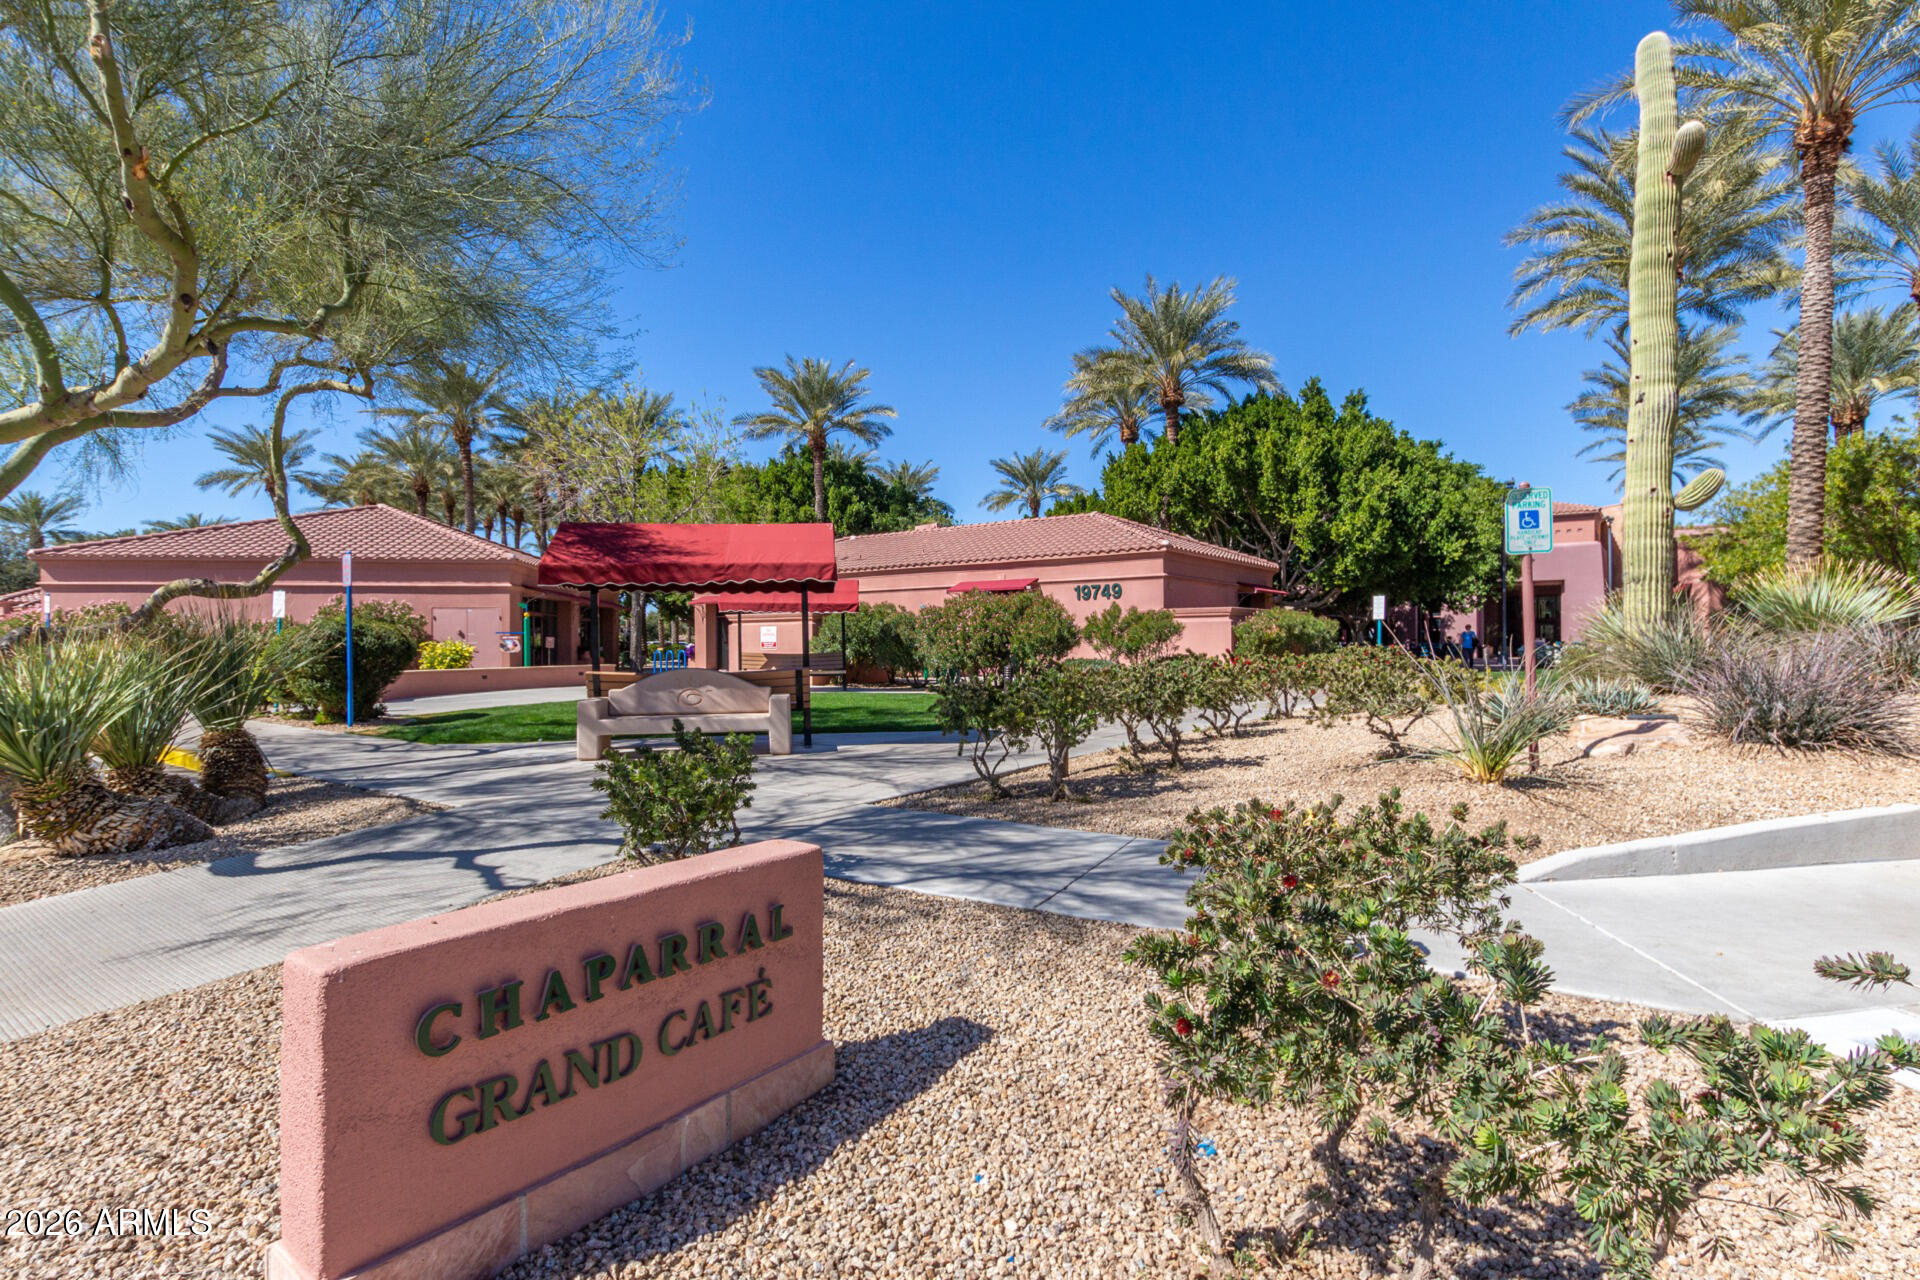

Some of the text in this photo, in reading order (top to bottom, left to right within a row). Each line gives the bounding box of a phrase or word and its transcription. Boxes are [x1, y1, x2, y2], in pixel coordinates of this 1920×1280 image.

[1073, 583, 1122, 601] 19749
[414, 903, 794, 1057] CHAPARRAL
[429, 967, 773, 1145] GRAND CAFÉ
